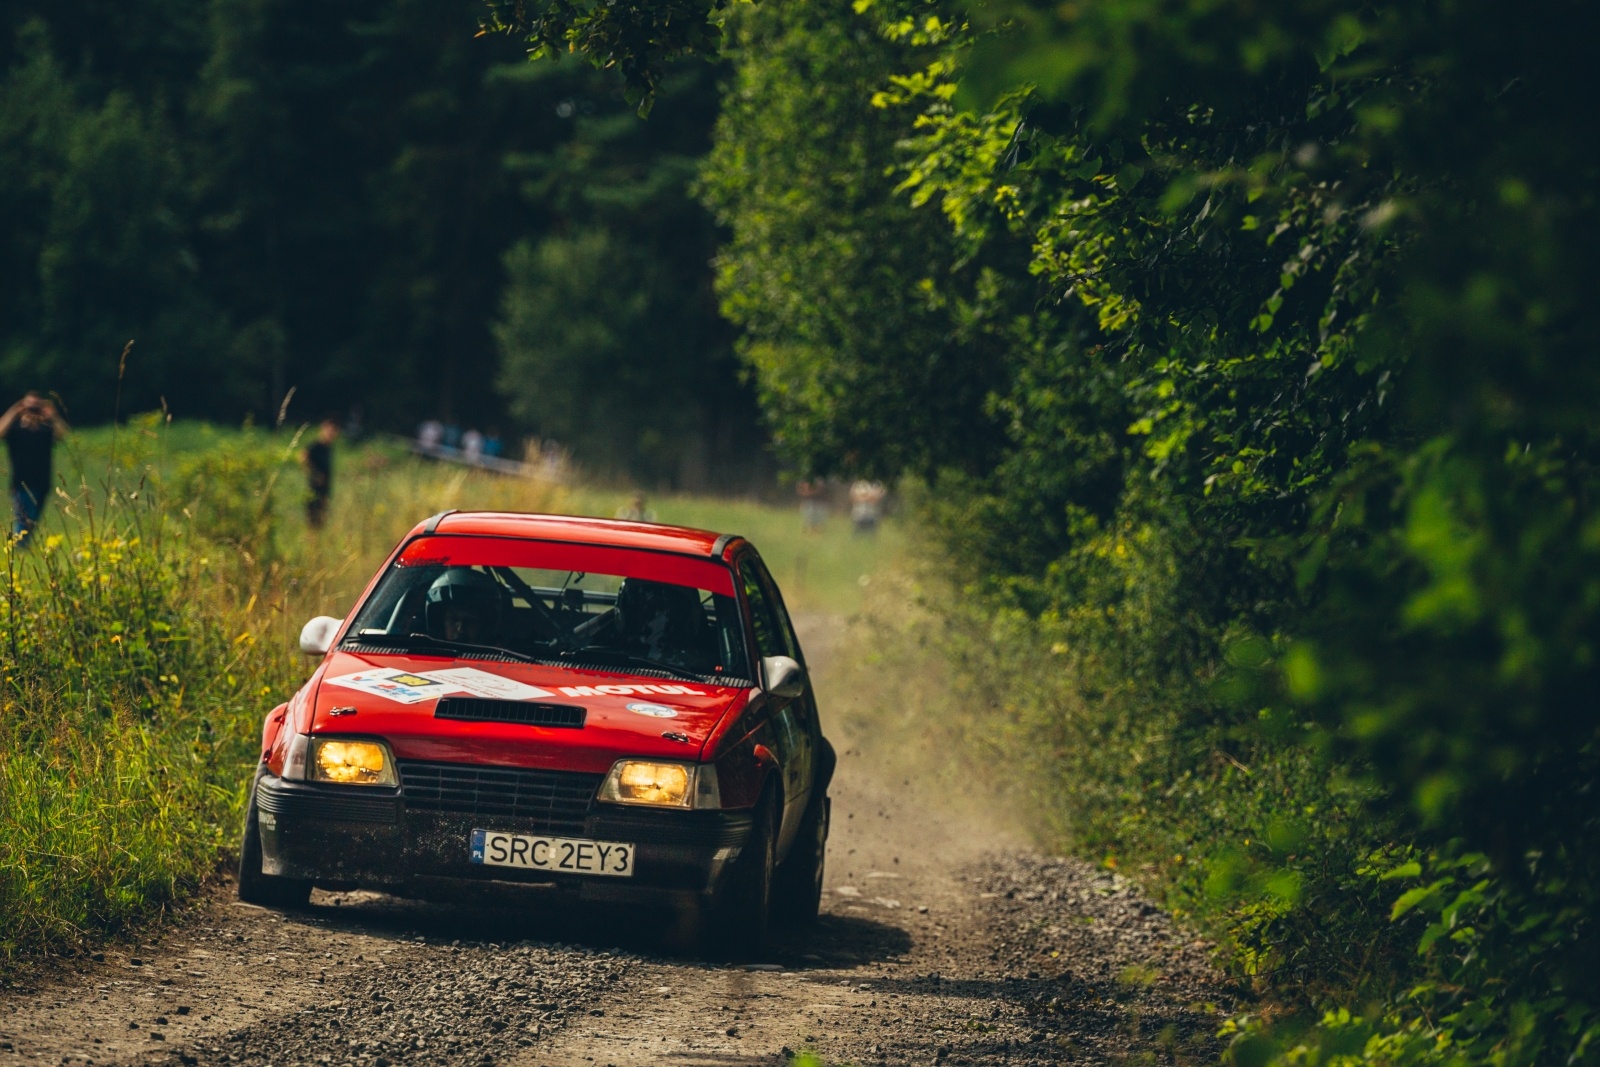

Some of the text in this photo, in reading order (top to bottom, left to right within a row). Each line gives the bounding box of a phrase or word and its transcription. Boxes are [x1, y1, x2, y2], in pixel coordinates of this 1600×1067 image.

[558, 684, 706, 697] MOTUL
[473, 850, 483, 859] PL
[490, 836, 629, 872] SRC 2EY3
